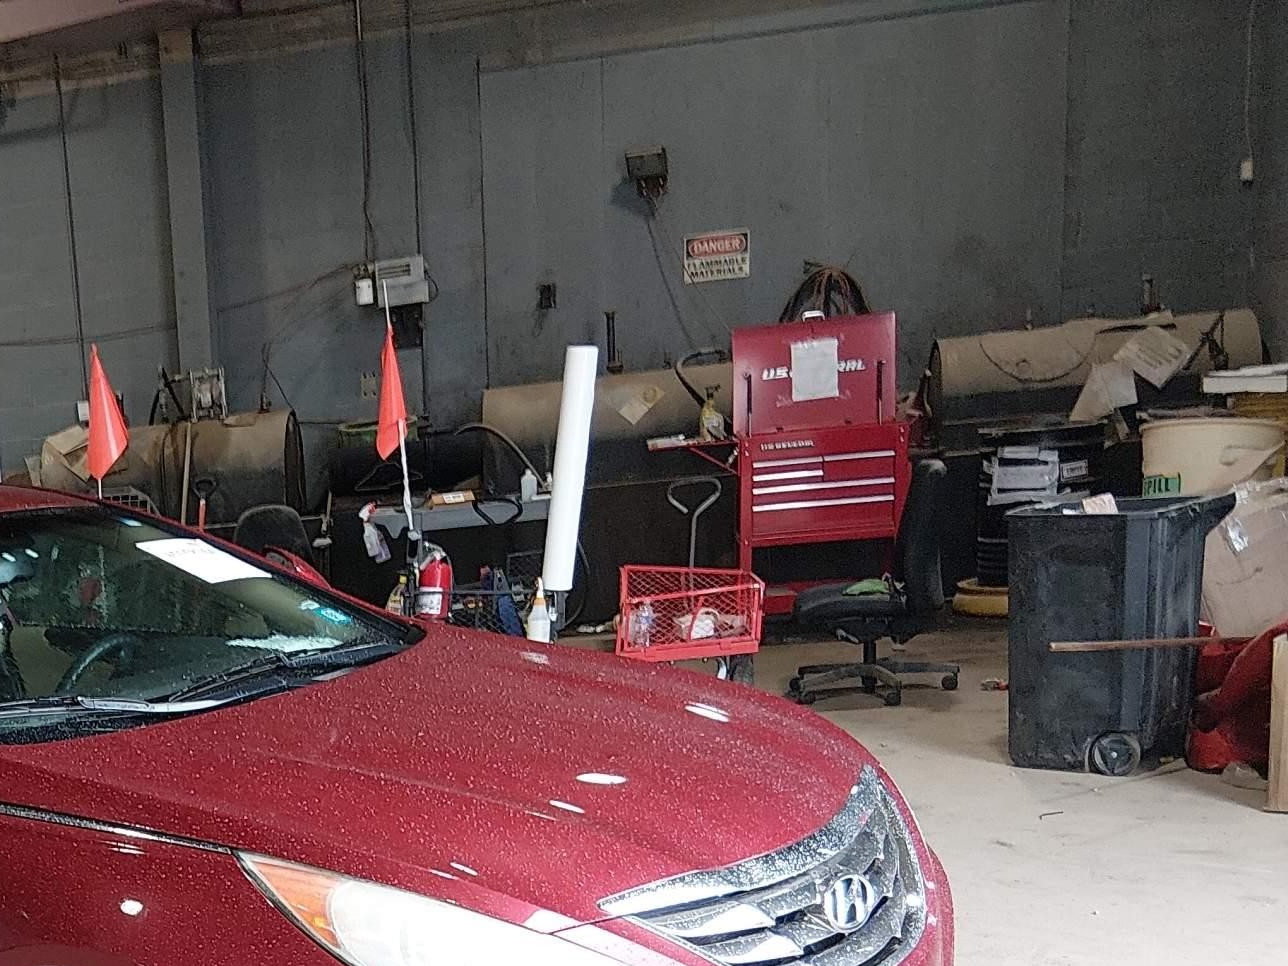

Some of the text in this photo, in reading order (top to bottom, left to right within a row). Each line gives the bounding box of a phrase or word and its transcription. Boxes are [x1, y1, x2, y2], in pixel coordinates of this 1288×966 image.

[693, 238, 741, 254] DANGER
[687, 256, 747, 270] FLAMMABLE
[691, 266, 744, 279] MATERIALS
